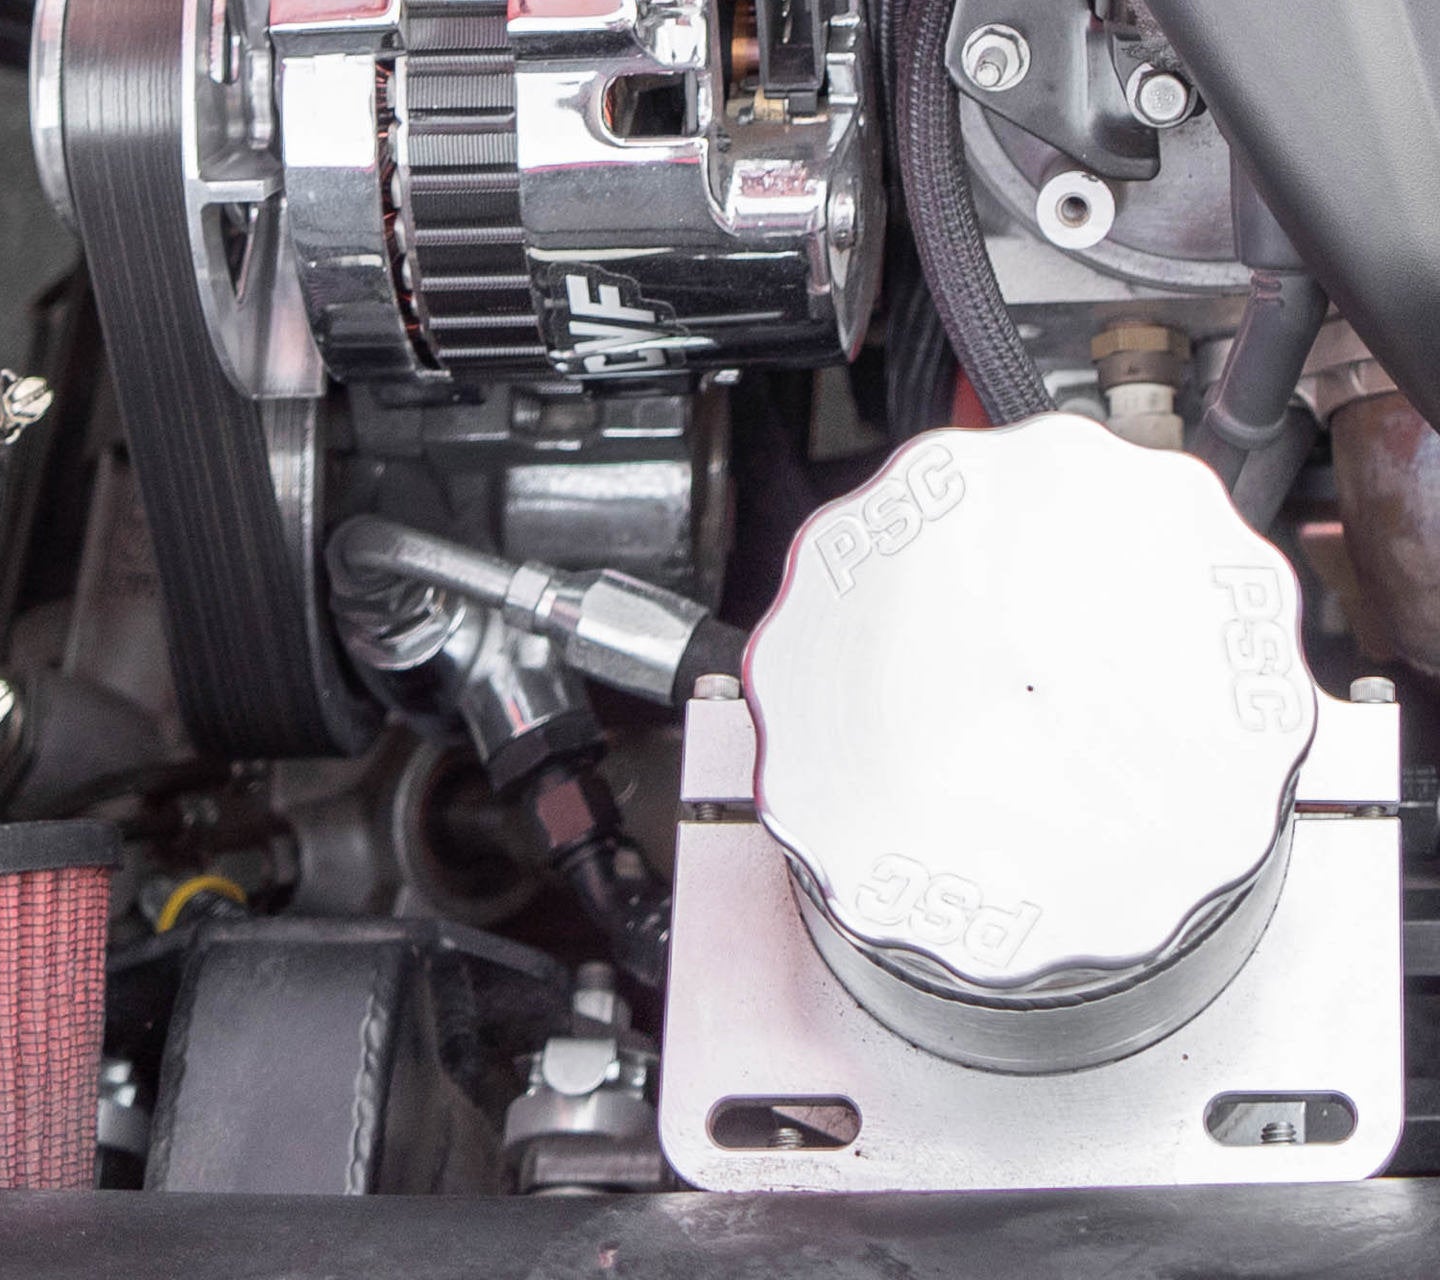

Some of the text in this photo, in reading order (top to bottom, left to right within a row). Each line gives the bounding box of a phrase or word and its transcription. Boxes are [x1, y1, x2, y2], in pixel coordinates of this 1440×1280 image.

[812, 442, 967, 600] PSC
[1210, 565, 1305, 734] PSC
[856, 851, 1043, 968] PSC
